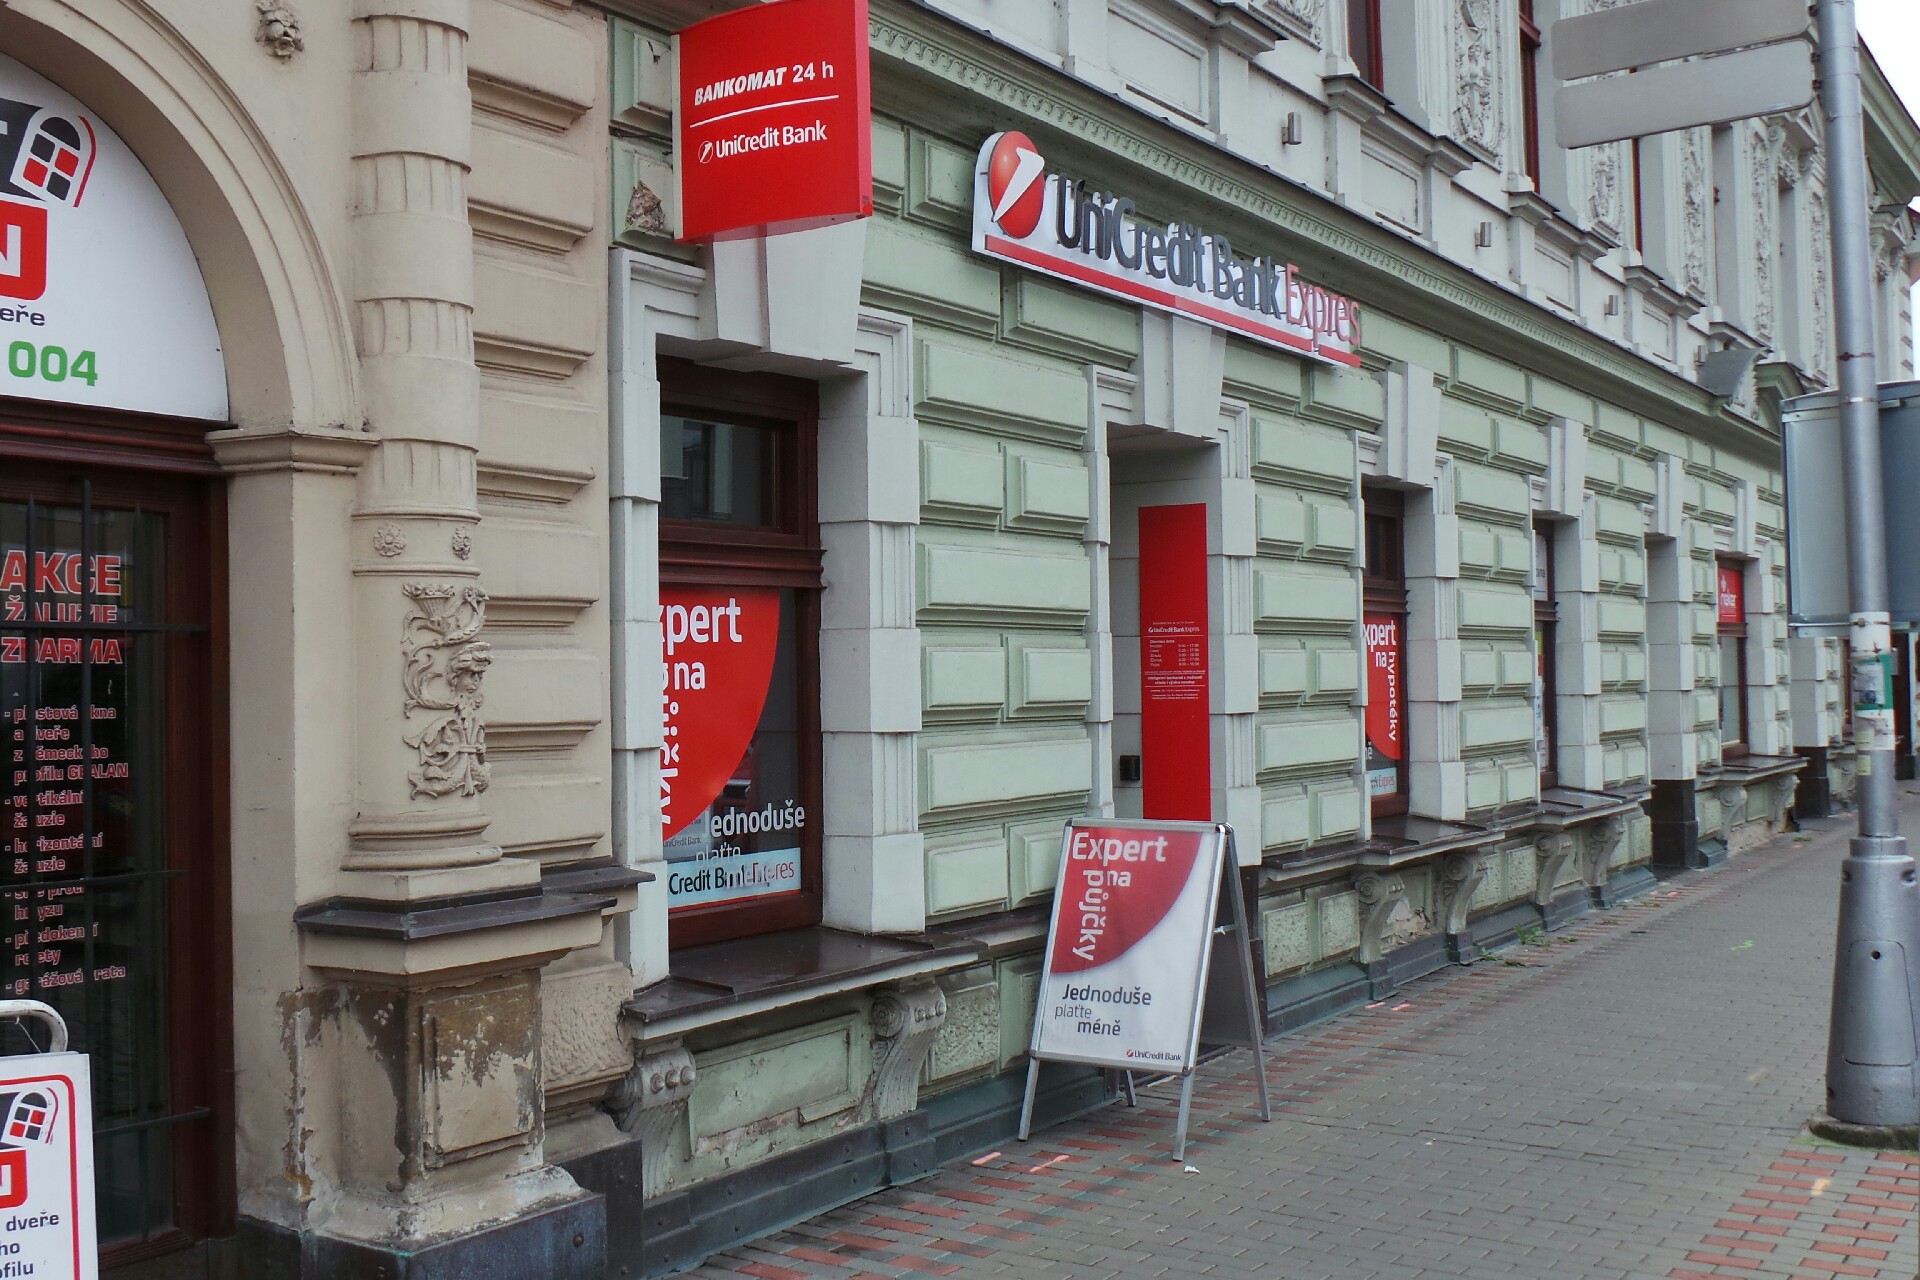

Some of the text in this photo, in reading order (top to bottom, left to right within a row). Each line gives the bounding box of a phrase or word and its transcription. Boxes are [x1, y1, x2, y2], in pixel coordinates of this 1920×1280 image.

[694, 60, 834, 106] BANKOMAT 24 h
[716, 119, 828, 158] UniCredit Bank
[1055, 171, 1362, 348] UniCredit Bank Expres
[8, 340, 98, 386] 004
[0, 550, 122, 596] AKCE
[1375, 651, 1387, 668] na
[673, 661, 706, 690] na
[1387, 651, 1399, 742] hypotéky
[13, 704, 117, 724] plstová kna
[35, 725, 70, 741] veře
[35, 743, 109, 761] ěmeckho
[13, 788, 84, 808] vetikální
[13, 810, 66, 828] žauzie
[704, 799, 805, 839] Jednoduše
[14, 831, 104, 854] hoizontání
[1071, 831, 1168, 867] Expert
[14, 855, 66, 874] žauzie
[1106, 869, 1132, 887] na
[14, 903, 64, 921] hyzu
[1072, 869, 1109, 961] půjčky
[15, 948, 62, 966] roety
[15, 965, 126, 994] gaážová rata
[1062, 983, 1152, 1006] Jednoduše
[1054, 1003, 1092, 1020] plaťte
[1077, 1018, 1121, 1036] méně
[1134, 1049, 1182, 1061] UniCredit Bank
[6, 1209, 60, 1232] dveře
